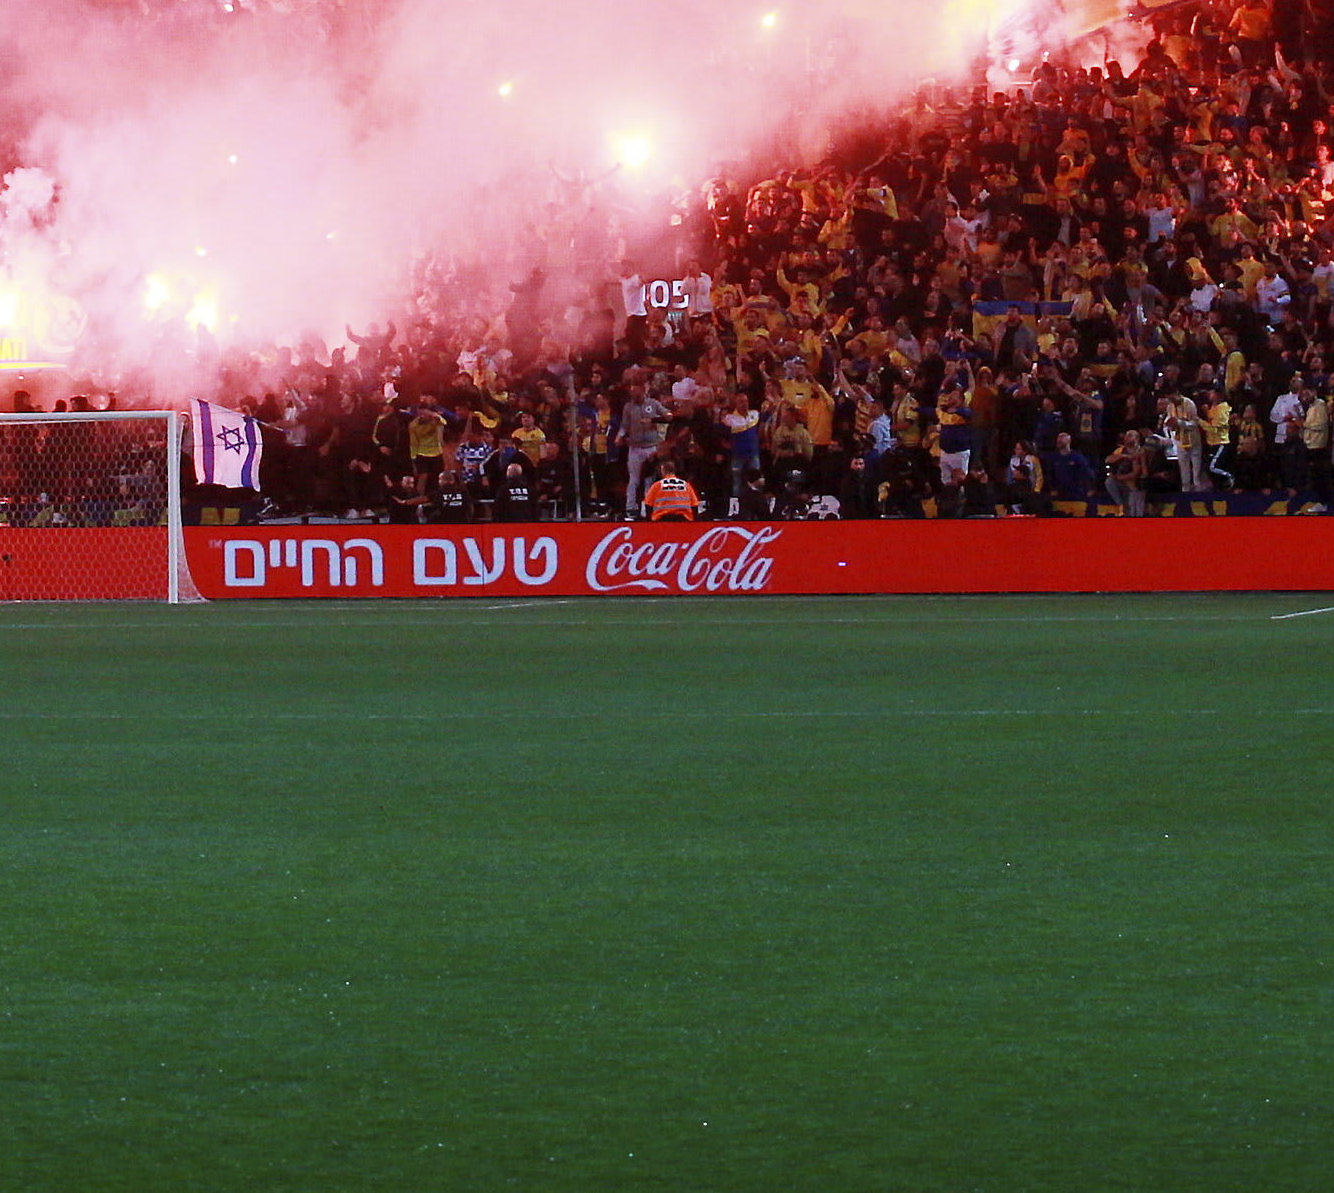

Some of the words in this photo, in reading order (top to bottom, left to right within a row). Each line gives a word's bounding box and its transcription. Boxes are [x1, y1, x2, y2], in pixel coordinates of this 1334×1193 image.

[224, 538, 384, 587] החיים
[413, 536, 558, 586] טעם
[585, 525, 784, 591] Coca-Cola
